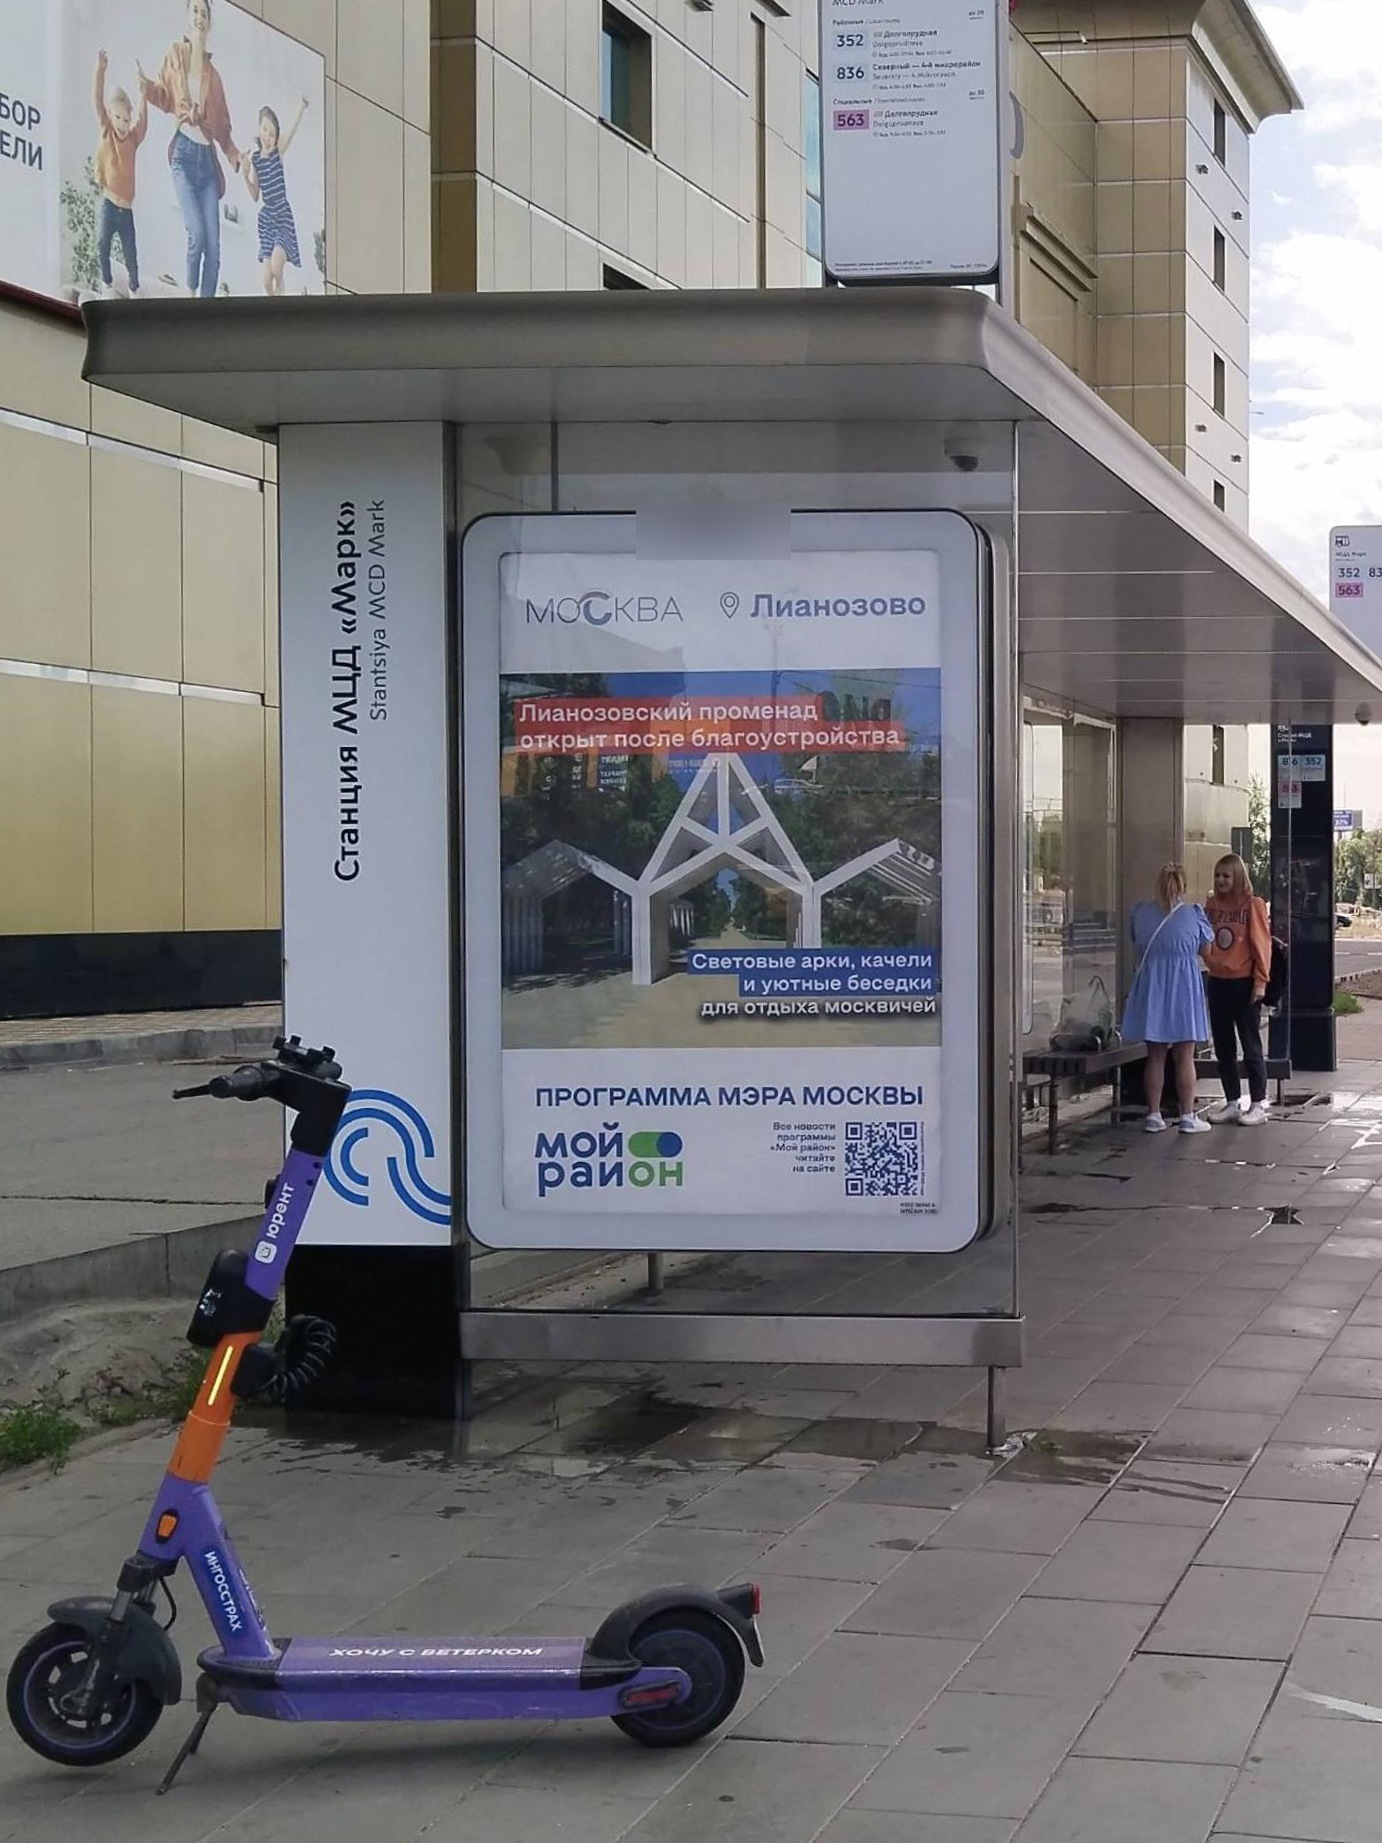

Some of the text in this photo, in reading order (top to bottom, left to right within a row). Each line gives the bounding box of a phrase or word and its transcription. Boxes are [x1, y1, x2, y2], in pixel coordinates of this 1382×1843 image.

[836, 33, 864, 48] 352
[836, 66, 865, 80] 836
[0, 92, 41, 131] БОР
[837, 113, 865, 127] 563
[0, 130, 43, 171] ЕЛИ
[1338, 567, 1360, 578] 352
[1338, 585, 1360, 595] 563
[366, 499, 391, 721] Stantsiya MCD Mark
[526, 590, 684, 626] МОСКВА
[750, 593, 926, 619] Лианозово
[331, 500, 361, 882] Станция МЦД «Марк»
[519, 701, 692, 725] Лианозовский
[699, 703, 819, 725] променад
[520, 726, 900, 751] открыт после благоустройства
[1282, 756, 1322, 766] 86 352
[691, 953, 933, 972] Световые арки, качели
[743, 974, 933, 996] и уютные беседки
[701, 996, 936, 1017] для отдыха москвичей
[536, 1085, 923, 1108] ПРОГРАММА МЭРА МОСКВЫ
[772, 1122, 836, 1131] Все новости
[535, 1121, 623, 1159] мой
[770, 1143, 836, 1153] «Мой район»
[777, 1133, 836, 1142] программы
[795, 1154, 836, 1162] читайте
[806, 1164, 836, 1173] сайте
[265, 1182, 295, 1239] юрент
[204, 1550, 242, 1632] ИНГОССТРАХ
[328, 1648, 544, 1657] ХОЧУ С ВЕТЕРКОМ
